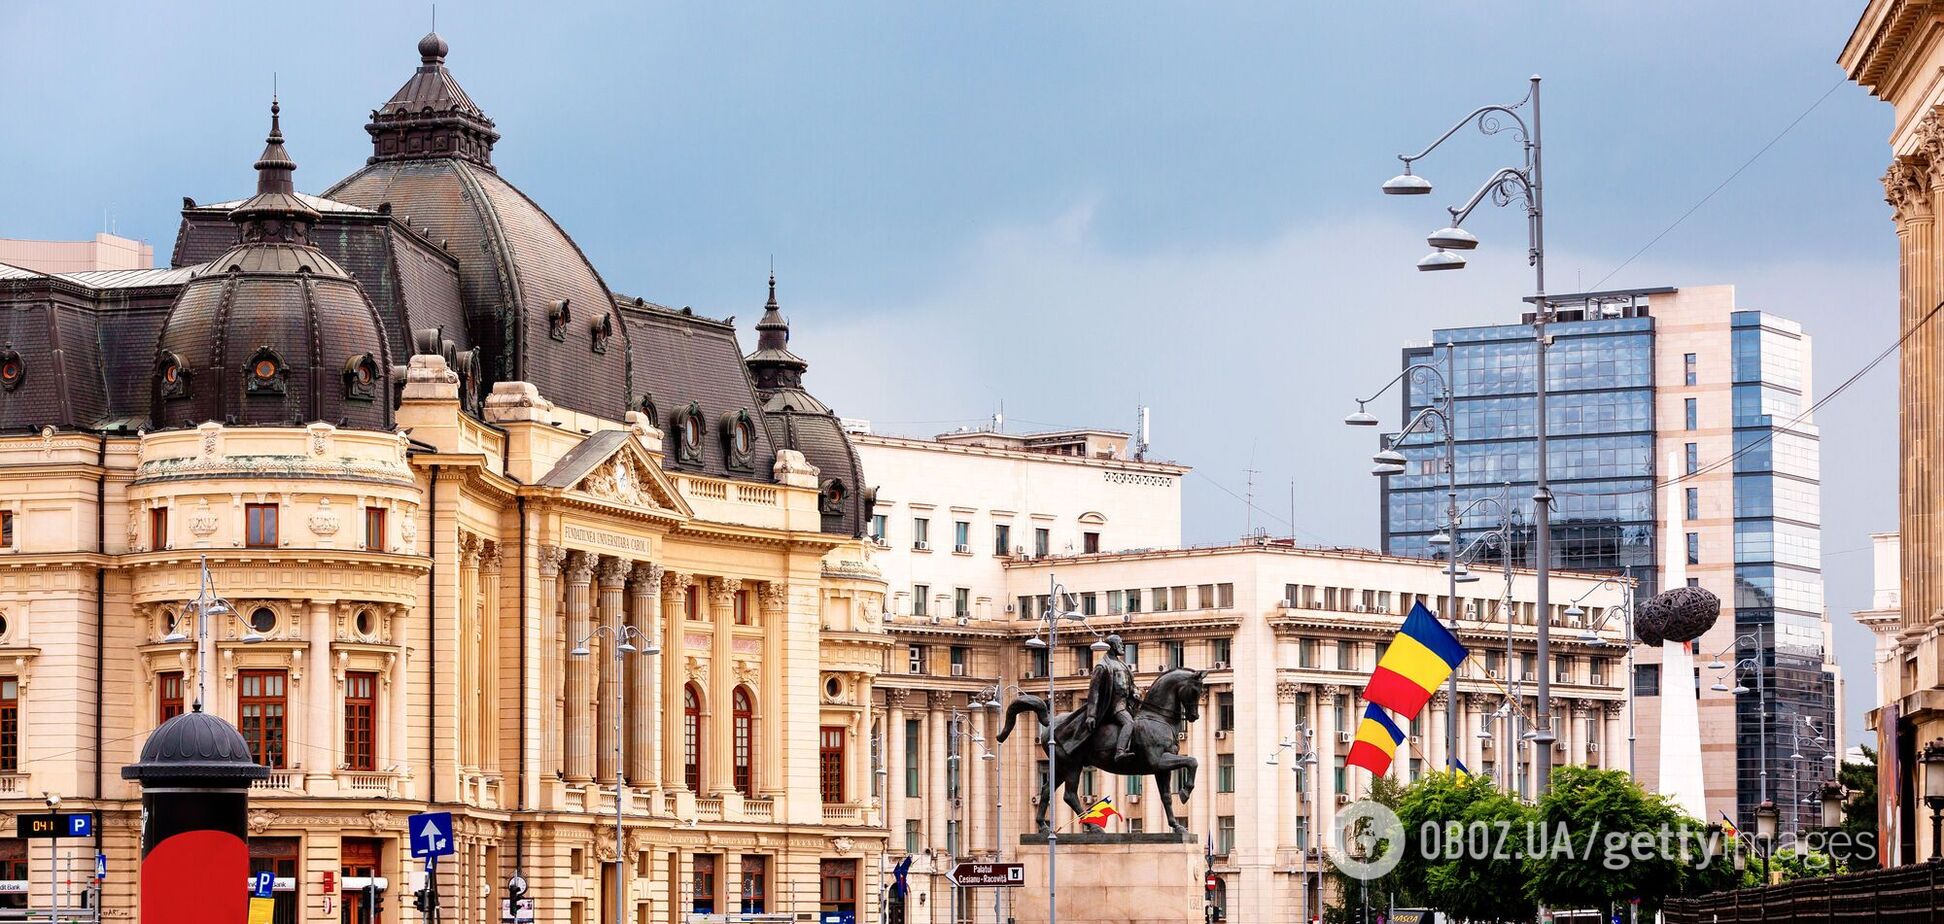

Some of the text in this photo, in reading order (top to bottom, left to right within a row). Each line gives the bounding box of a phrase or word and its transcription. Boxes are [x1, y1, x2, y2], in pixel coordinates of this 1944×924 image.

[74, 818, 86, 832] P
[973, 865, 993, 874] Palatul
[259, 873, 271, 894] P
